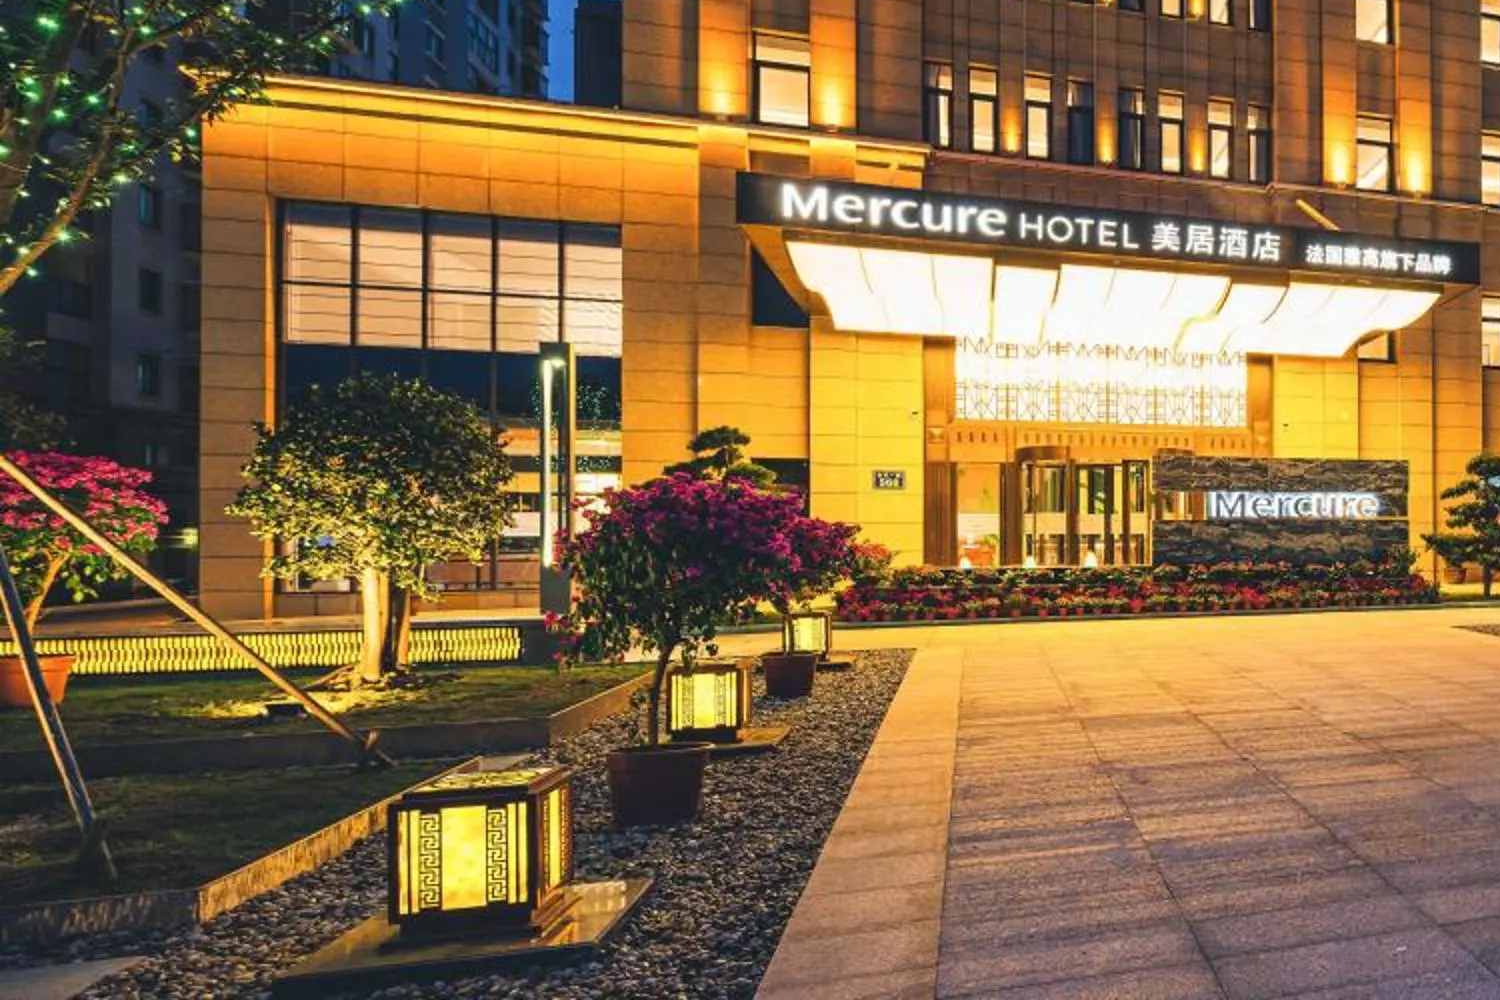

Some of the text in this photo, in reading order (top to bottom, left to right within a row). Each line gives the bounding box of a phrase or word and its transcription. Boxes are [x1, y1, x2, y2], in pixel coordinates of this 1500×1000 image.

[780, 182, 1282, 262] Mercure HOTEL 美居酒店
[1214, 491, 1380, 520] Mercure
